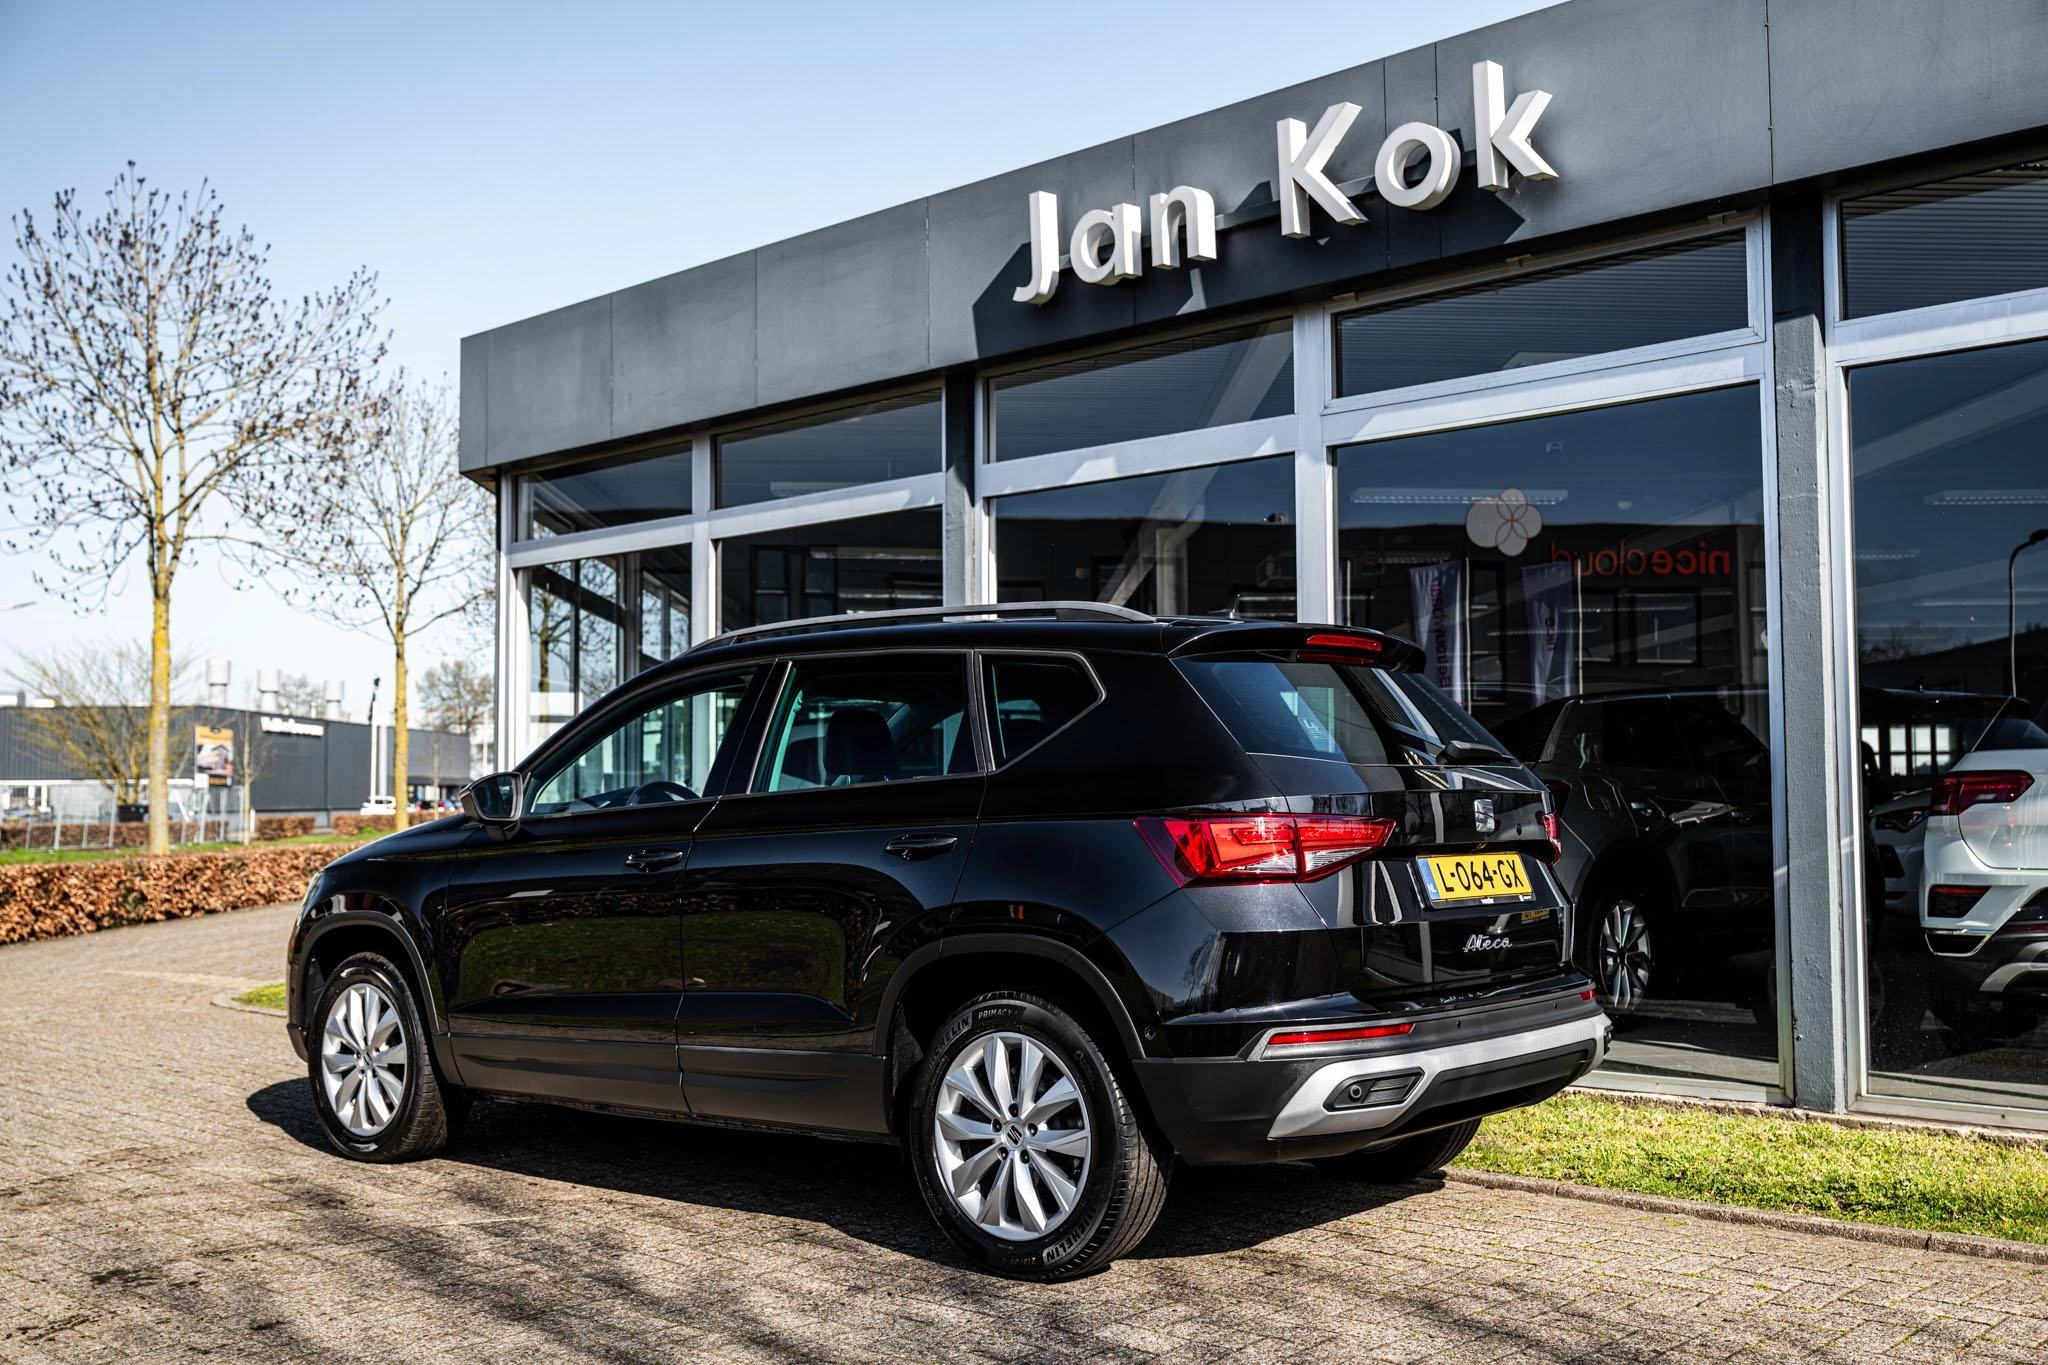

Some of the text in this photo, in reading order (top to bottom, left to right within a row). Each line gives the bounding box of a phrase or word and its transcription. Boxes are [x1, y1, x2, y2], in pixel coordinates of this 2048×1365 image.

[1013, 59, 1560, 305] Jan Kok
[1436, 859, 1524, 892] L-064-GX
[1462, 934, 1513, 953] Ateca
[977, 1008, 1014, 1021] PRIMACY
